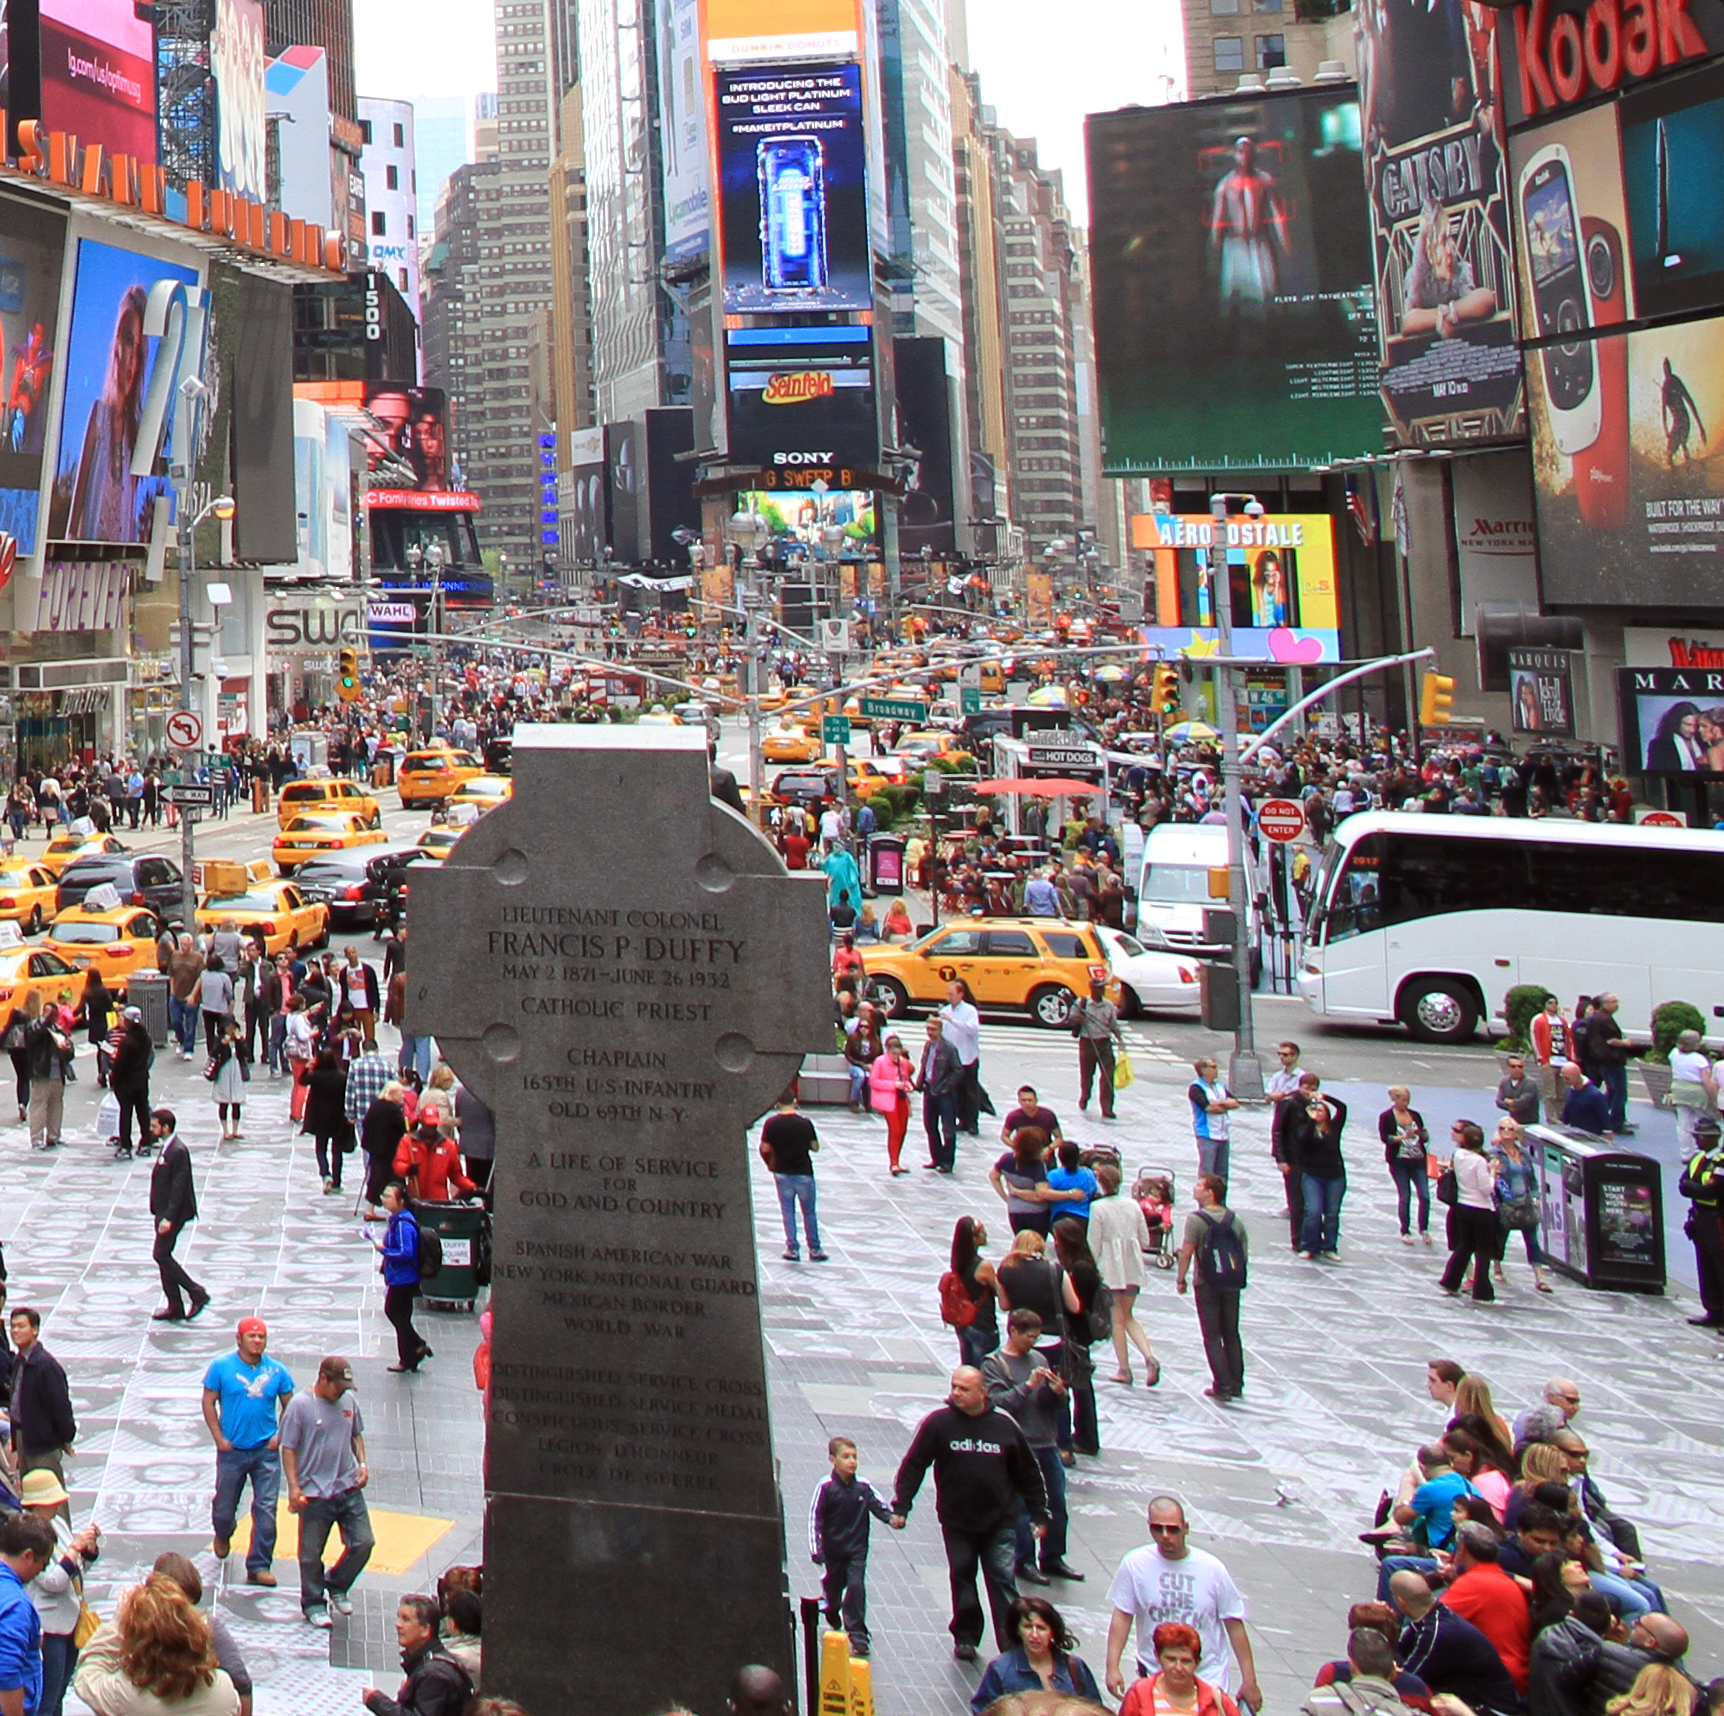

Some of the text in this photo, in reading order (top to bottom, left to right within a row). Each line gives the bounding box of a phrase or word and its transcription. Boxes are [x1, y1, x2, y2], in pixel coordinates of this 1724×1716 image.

[67, 47, 142, 103] lg.com/us/optimusg
[729, 78, 841, 92] INTRODUCING THE
[722, 89, 851, 104] BUD LIGHT PLATINUM
[1380, 132, 1484, 222] GATSBY
[365, 273, 380, 341] 1500
[764, 372, 834, 402] Seinfeld
[773, 451, 834, 466] SONY
[430, 494, 465, 509] Twisted
[1646, 499, 1720, 518] BUILT FOR THE WAY
[38, 561, 129, 632] FOREVER
[370, 603, 411, 619] WAHL
[1509, 652, 1567, 669] MARQUIS
[868, 703, 916, 719] Broadway
[1046, 751, 1094, 763] HOT DOGS
[1262, 804, 1296, 815] DO NOT
[1267, 825, 1295, 835] ENTER
[502, 906, 725, 933] LIEUTENANT COLONEL
[487, 931, 746, 964] FRANCIS DUFFY
[520, 997, 712, 1022] CATHOLIC PRIEST
[567, 1047, 667, 1070] CHAPLAIN
[1603, 1185, 1625, 1193] START
[515, 1240, 733, 1271] SPANISH AMERICAN WAR
[1159, 1572, 1195, 1590] CUT
[1160, 1591, 1194, 1610] THE
